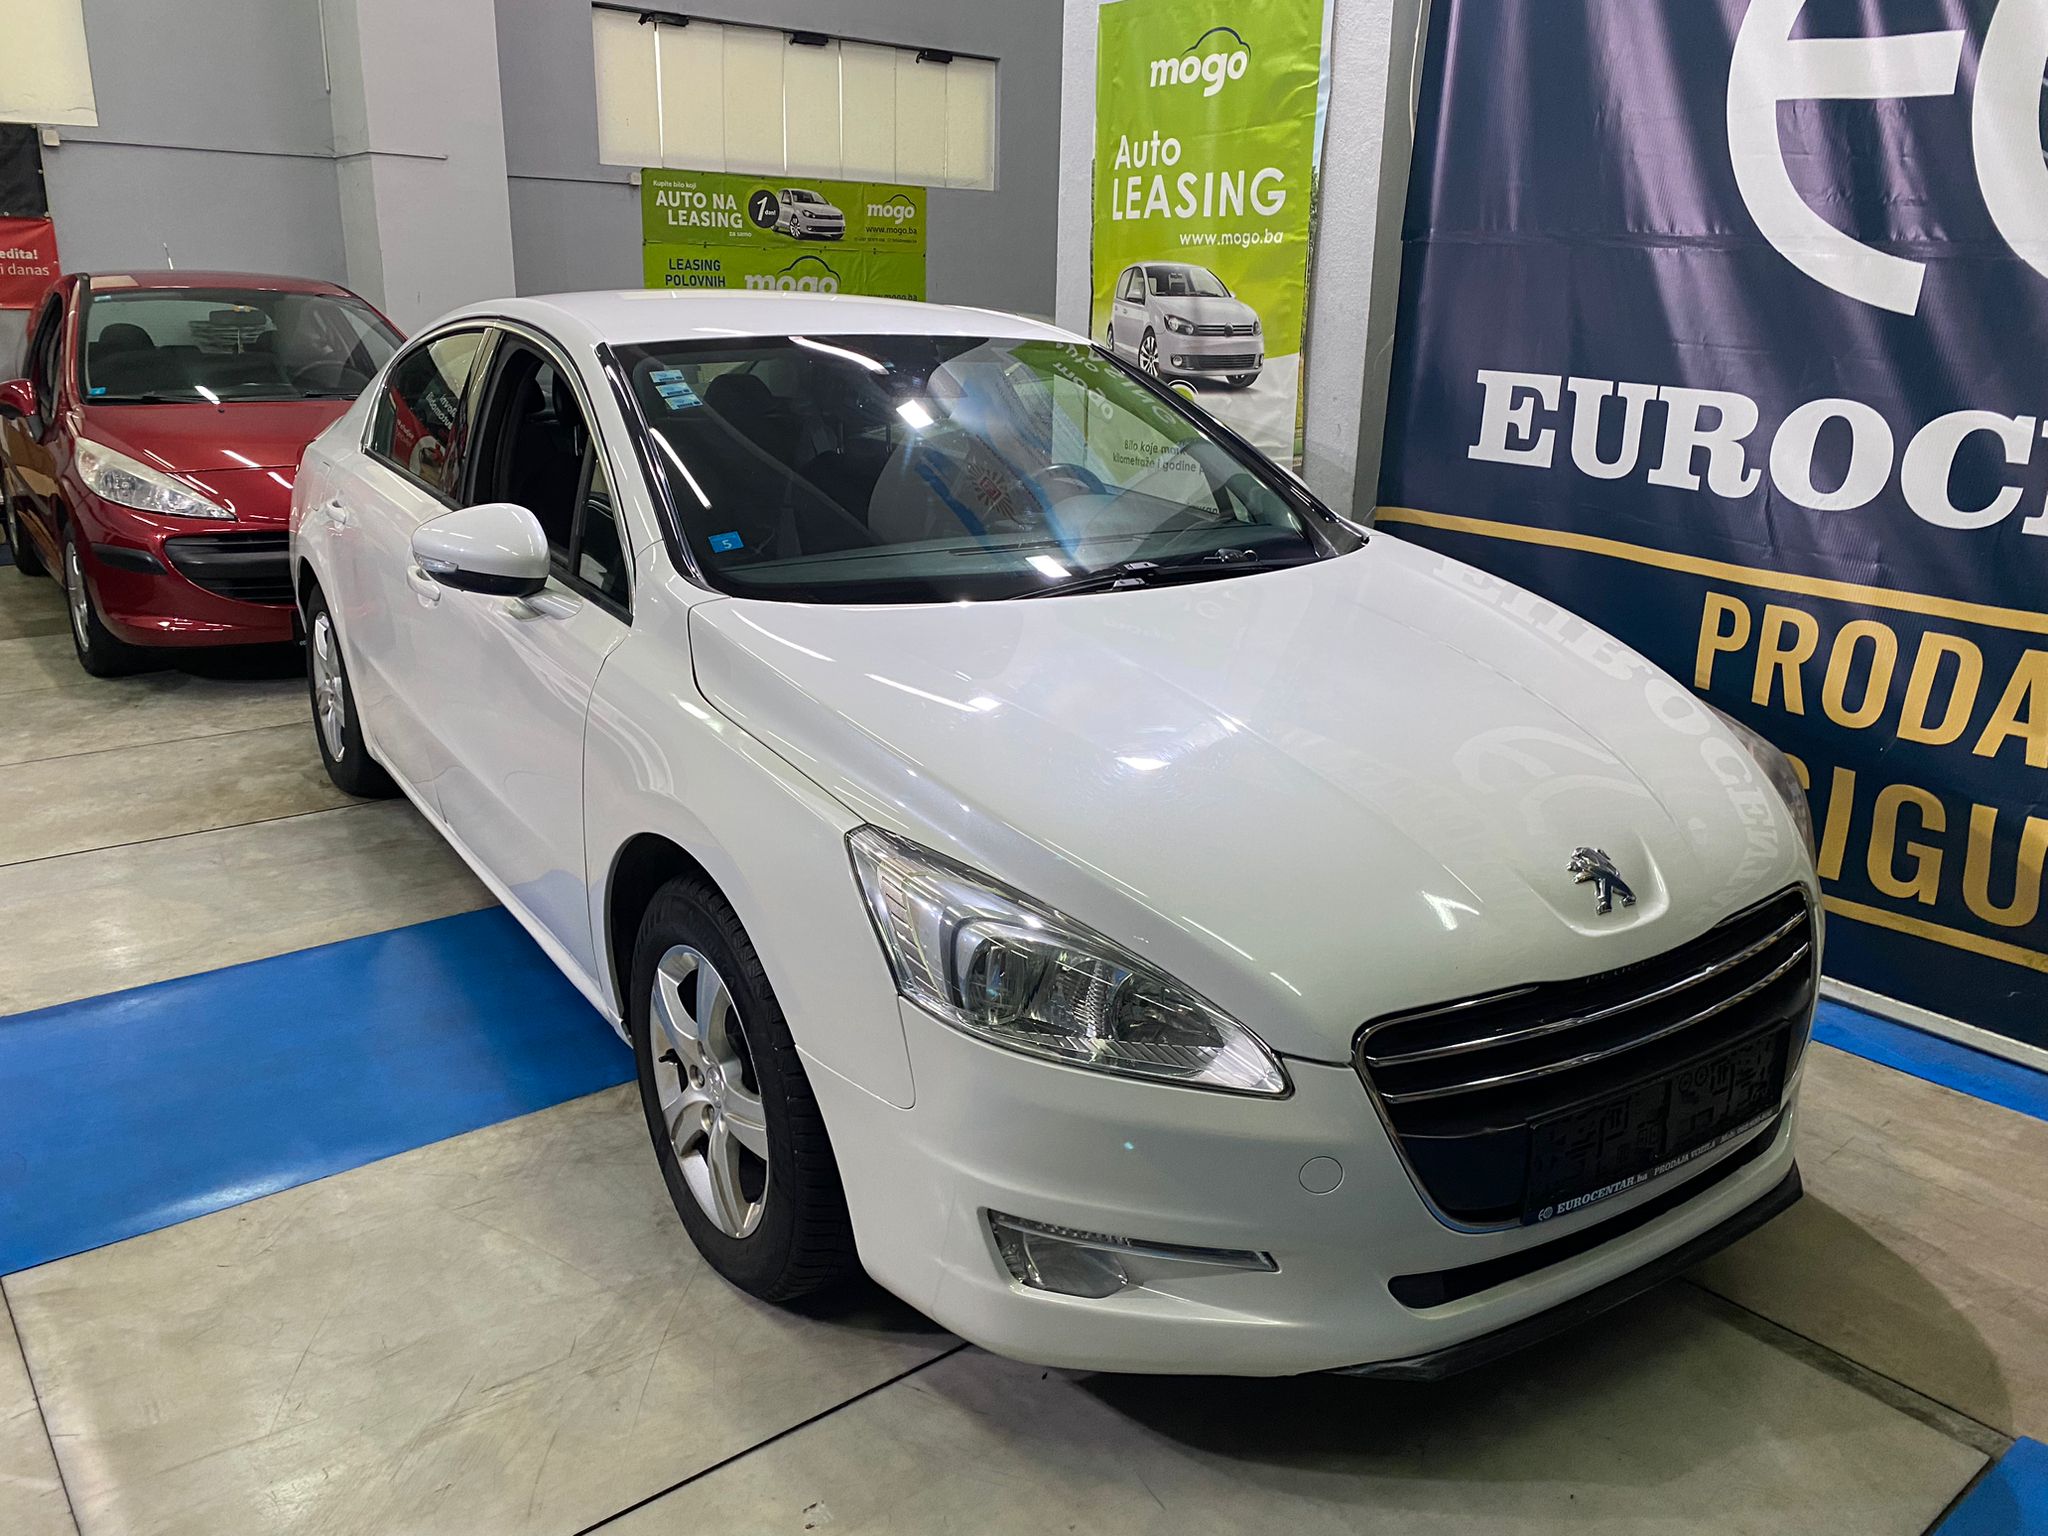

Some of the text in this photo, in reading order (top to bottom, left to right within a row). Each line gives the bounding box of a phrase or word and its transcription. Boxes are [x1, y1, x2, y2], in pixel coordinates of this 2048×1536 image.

[1150, 50, 1248, 97] mogo
[1114, 130, 1181, 170] Auto
[655, 190, 738, 211] AUTO NA
[1112, 167, 1287, 220] LEASING
[756, 196, 768, 221] 1
[866, 202, 915, 224] mogo
[668, 209, 743, 229] LEASING
[865, 225, 918, 236] www.mogo.ba
[1179, 228, 1284, 248] www.mogo.ba
[7, 262, 50, 276] danas
[668, 258, 721, 272] LEASING
[664, 274, 727, 288] POLOVNIH
[1124, 439, 1138, 451] Bilo
[1140, 440, 1159, 455] koje
[1467, 369, 2048, 536] EUROC
[1162, 459, 1197, 472] godine
[721, 538, 733, 550] 5
[1694, 591, 2048, 769] PRODA
